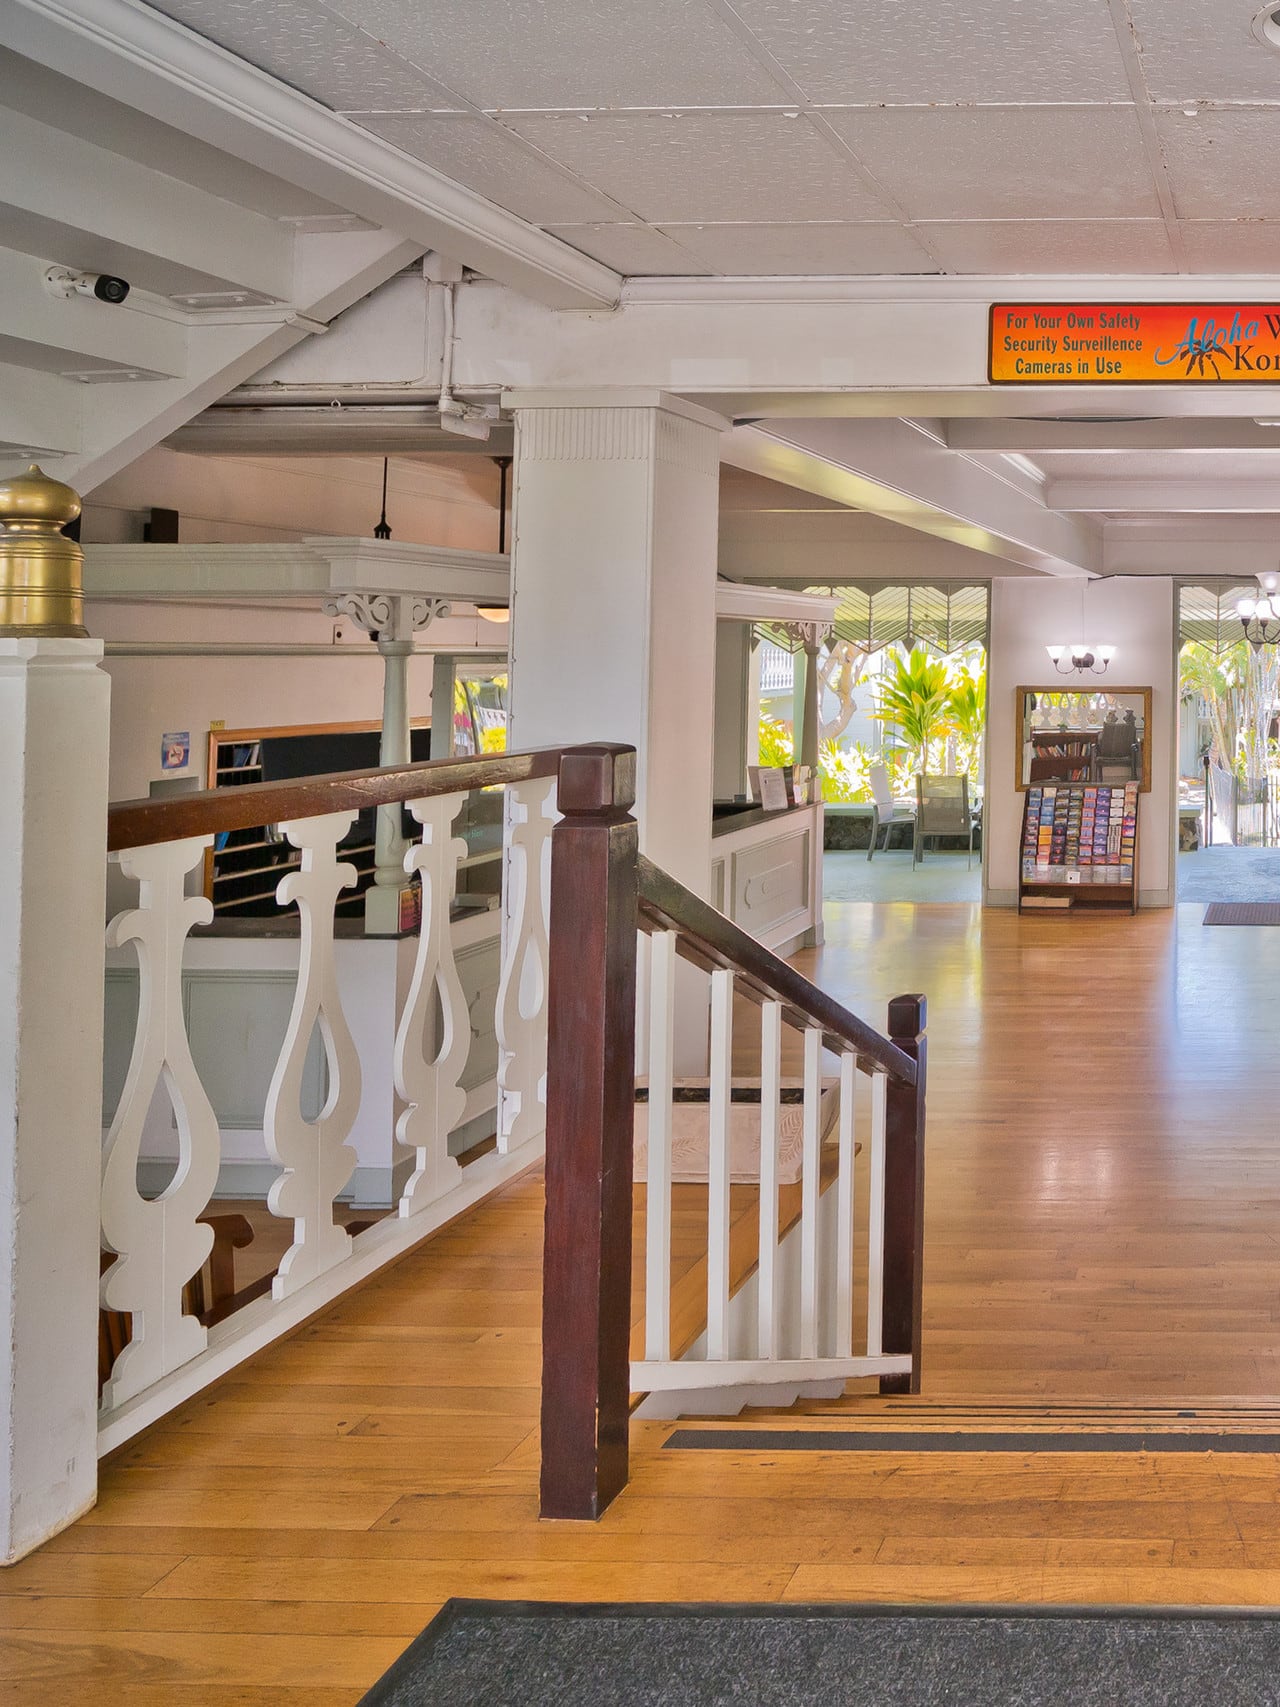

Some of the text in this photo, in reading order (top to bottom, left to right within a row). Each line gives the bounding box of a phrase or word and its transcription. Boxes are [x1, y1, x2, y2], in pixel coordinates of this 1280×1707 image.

[1006, 312, 1141, 332] For Your Own Safety
[1003, 336, 1143, 354] Security Surveillence
[1154, 311, 1260, 366] Aloha
[1015, 356, 1122, 374] Cameras in Use
